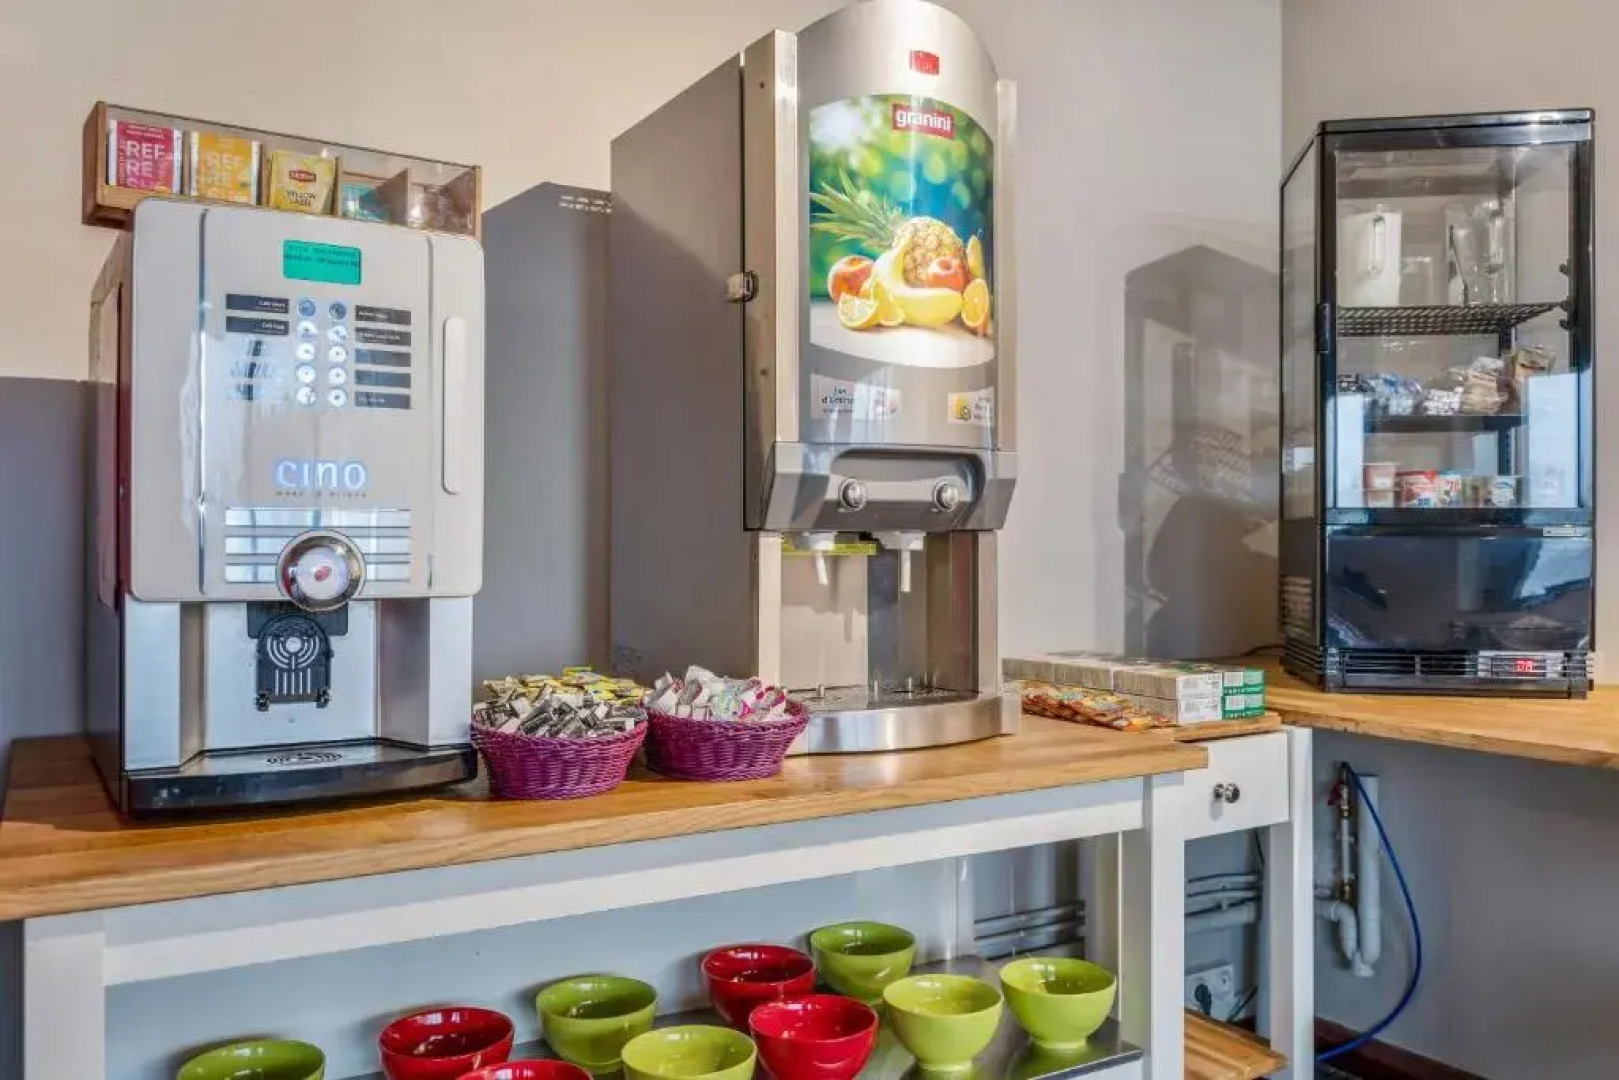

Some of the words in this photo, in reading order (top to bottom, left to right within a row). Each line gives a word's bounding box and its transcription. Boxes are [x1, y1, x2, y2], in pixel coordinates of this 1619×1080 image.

[895, 108, 952, 132] granini
[126, 140, 166, 161] REF
[126, 159, 153, 178] RE
[276, 460, 366, 489] cino
